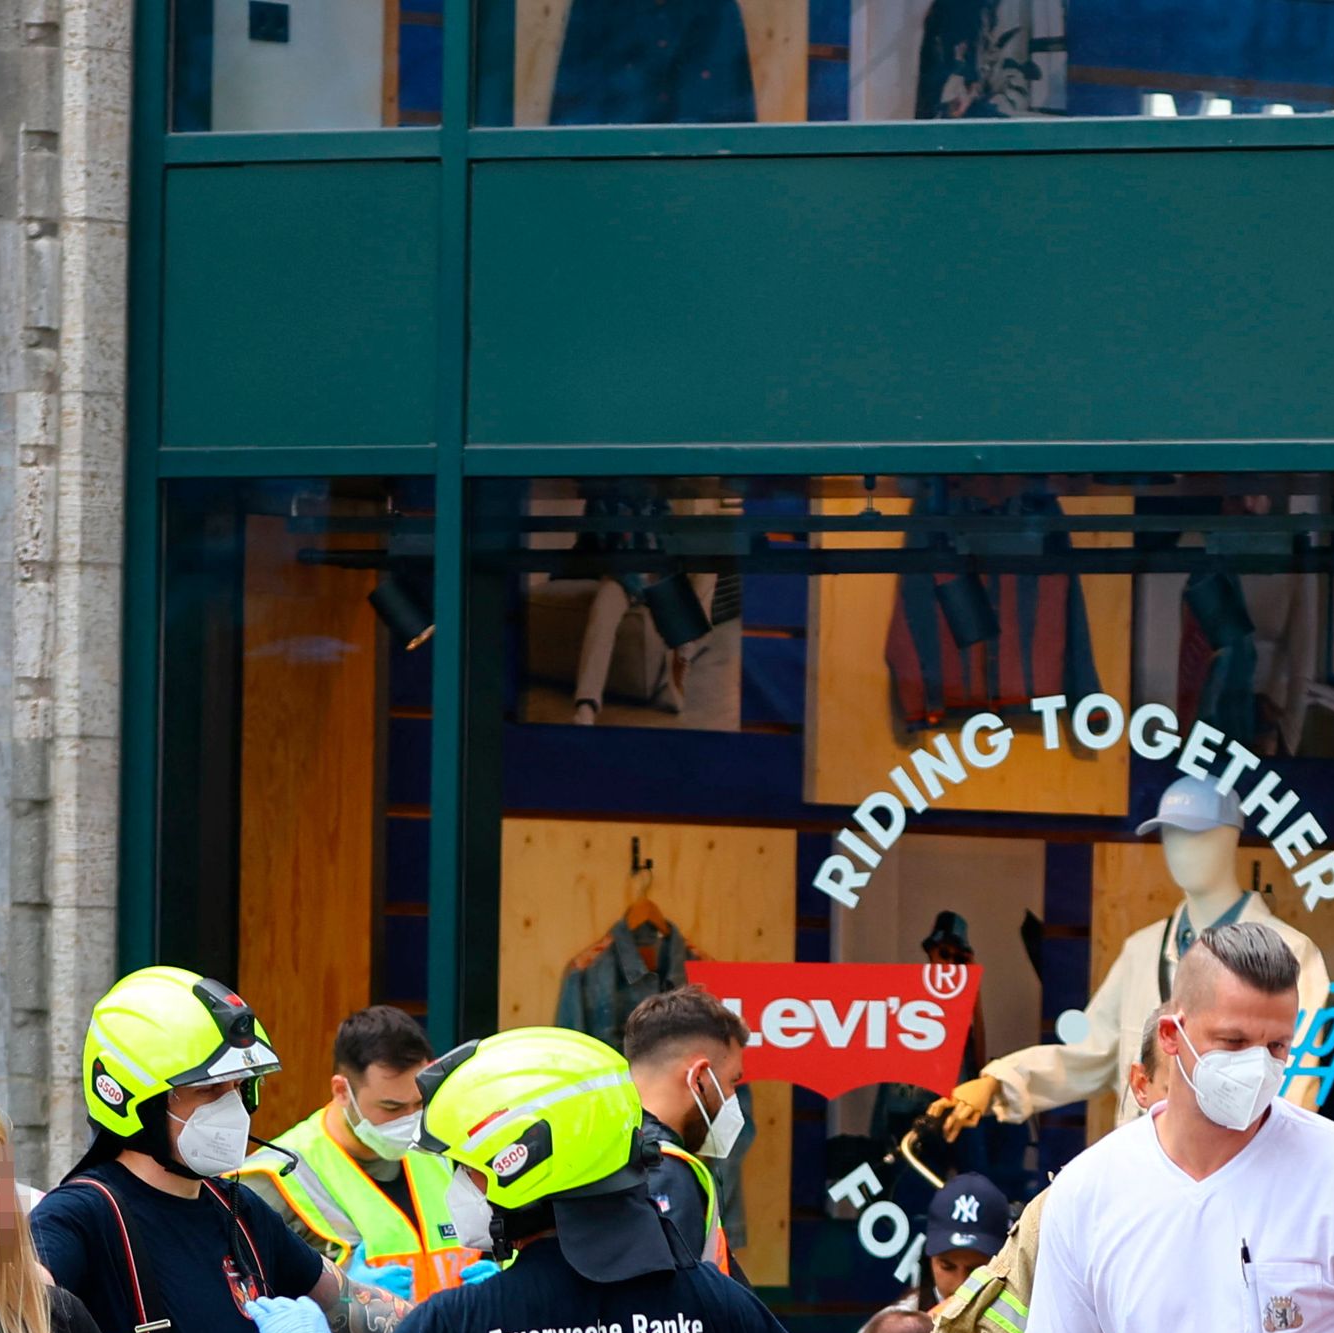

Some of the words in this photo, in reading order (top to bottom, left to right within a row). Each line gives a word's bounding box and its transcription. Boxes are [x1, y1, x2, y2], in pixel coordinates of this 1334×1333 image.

[812, 712, 1014, 909] RIDING
[98, 1078, 122, 1102] 3500
[494, 1146, 526, 1174] 3500
